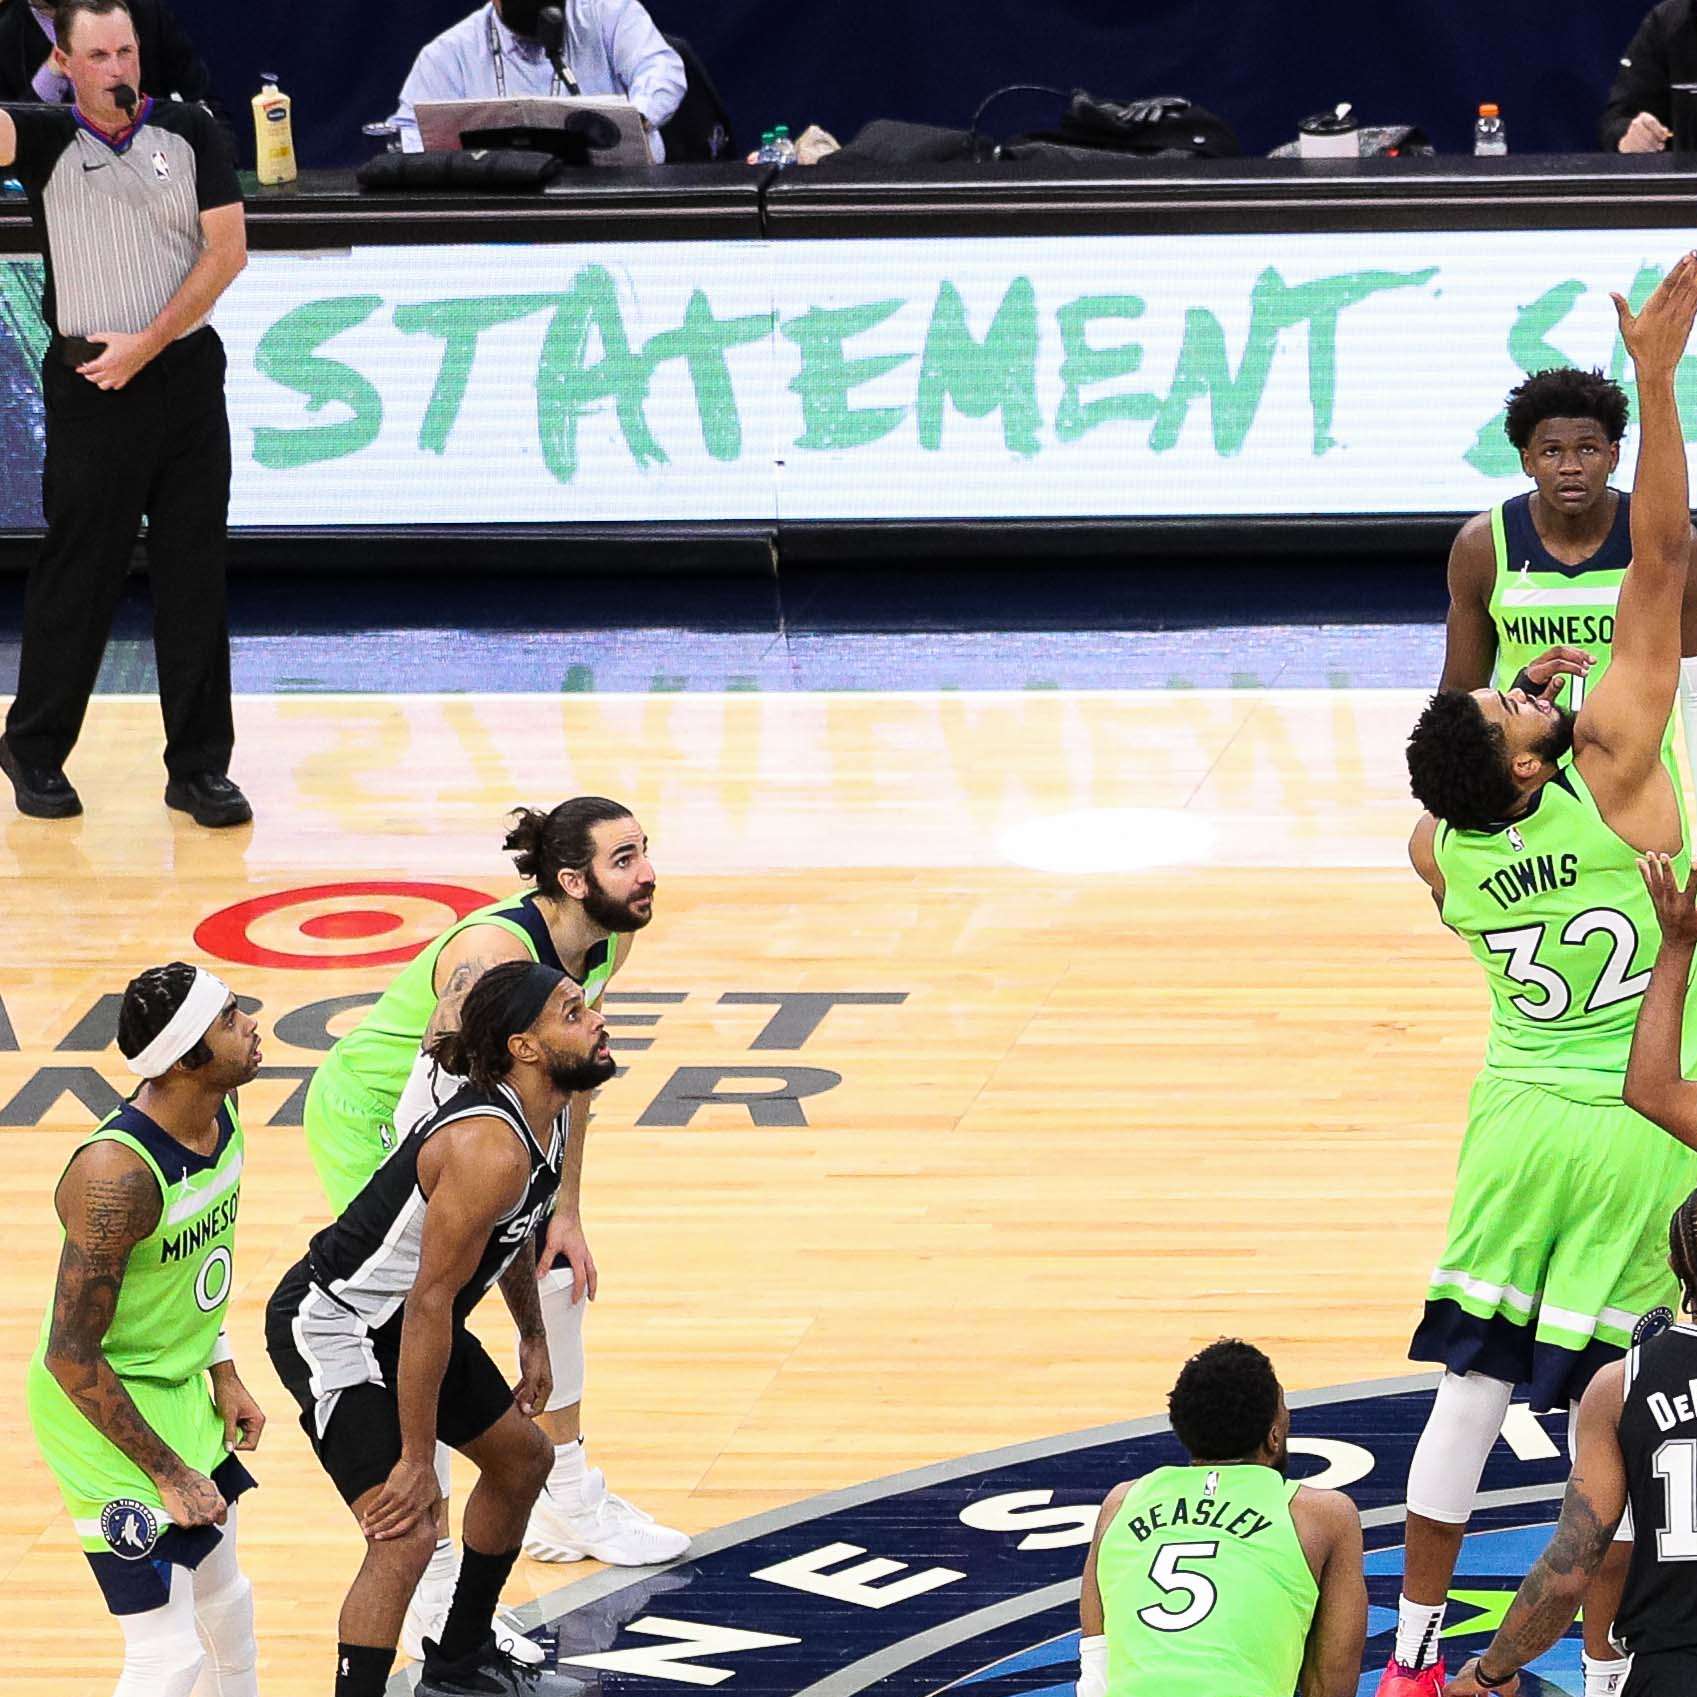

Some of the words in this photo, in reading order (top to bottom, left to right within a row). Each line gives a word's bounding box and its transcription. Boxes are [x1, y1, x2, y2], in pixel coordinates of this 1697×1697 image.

[250, 262, 1443, 485] STATEMENT
[1478, 851, 1580, 911] TOWNS
[1481, 906, 1653, 1022] 32
[160, 1185, 240, 1264] MINNESO
[193, 1244, 233, 1313] 0
[1128, 1496, 1274, 1542] BEASLEY
[1136, 1540, 1220, 1633] 5
